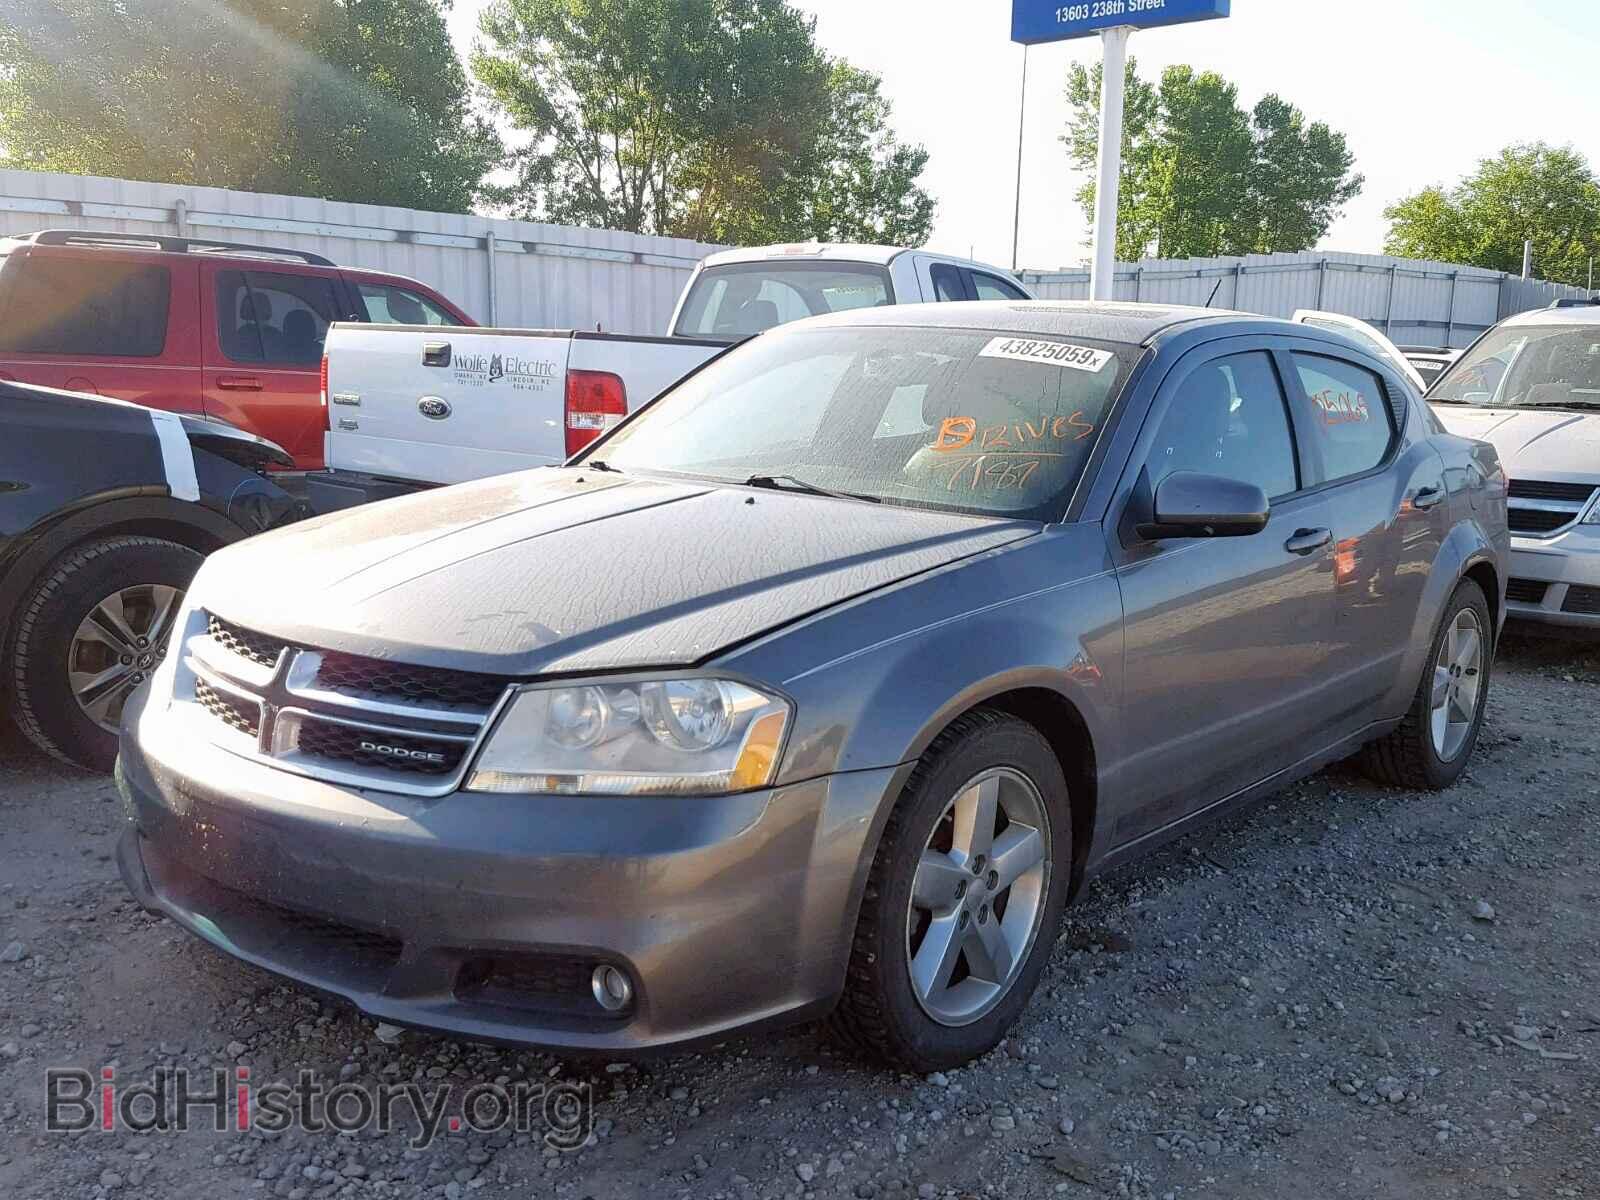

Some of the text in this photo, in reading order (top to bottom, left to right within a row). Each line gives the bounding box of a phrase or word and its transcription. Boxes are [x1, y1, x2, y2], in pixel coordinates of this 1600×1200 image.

[1056, 0, 1165, 22] 13603 238th Street
[454, 353, 556, 376] Wolfe Electric
[423, 400, 443, 414] Ford
[361, 742, 445, 762] DODGE
